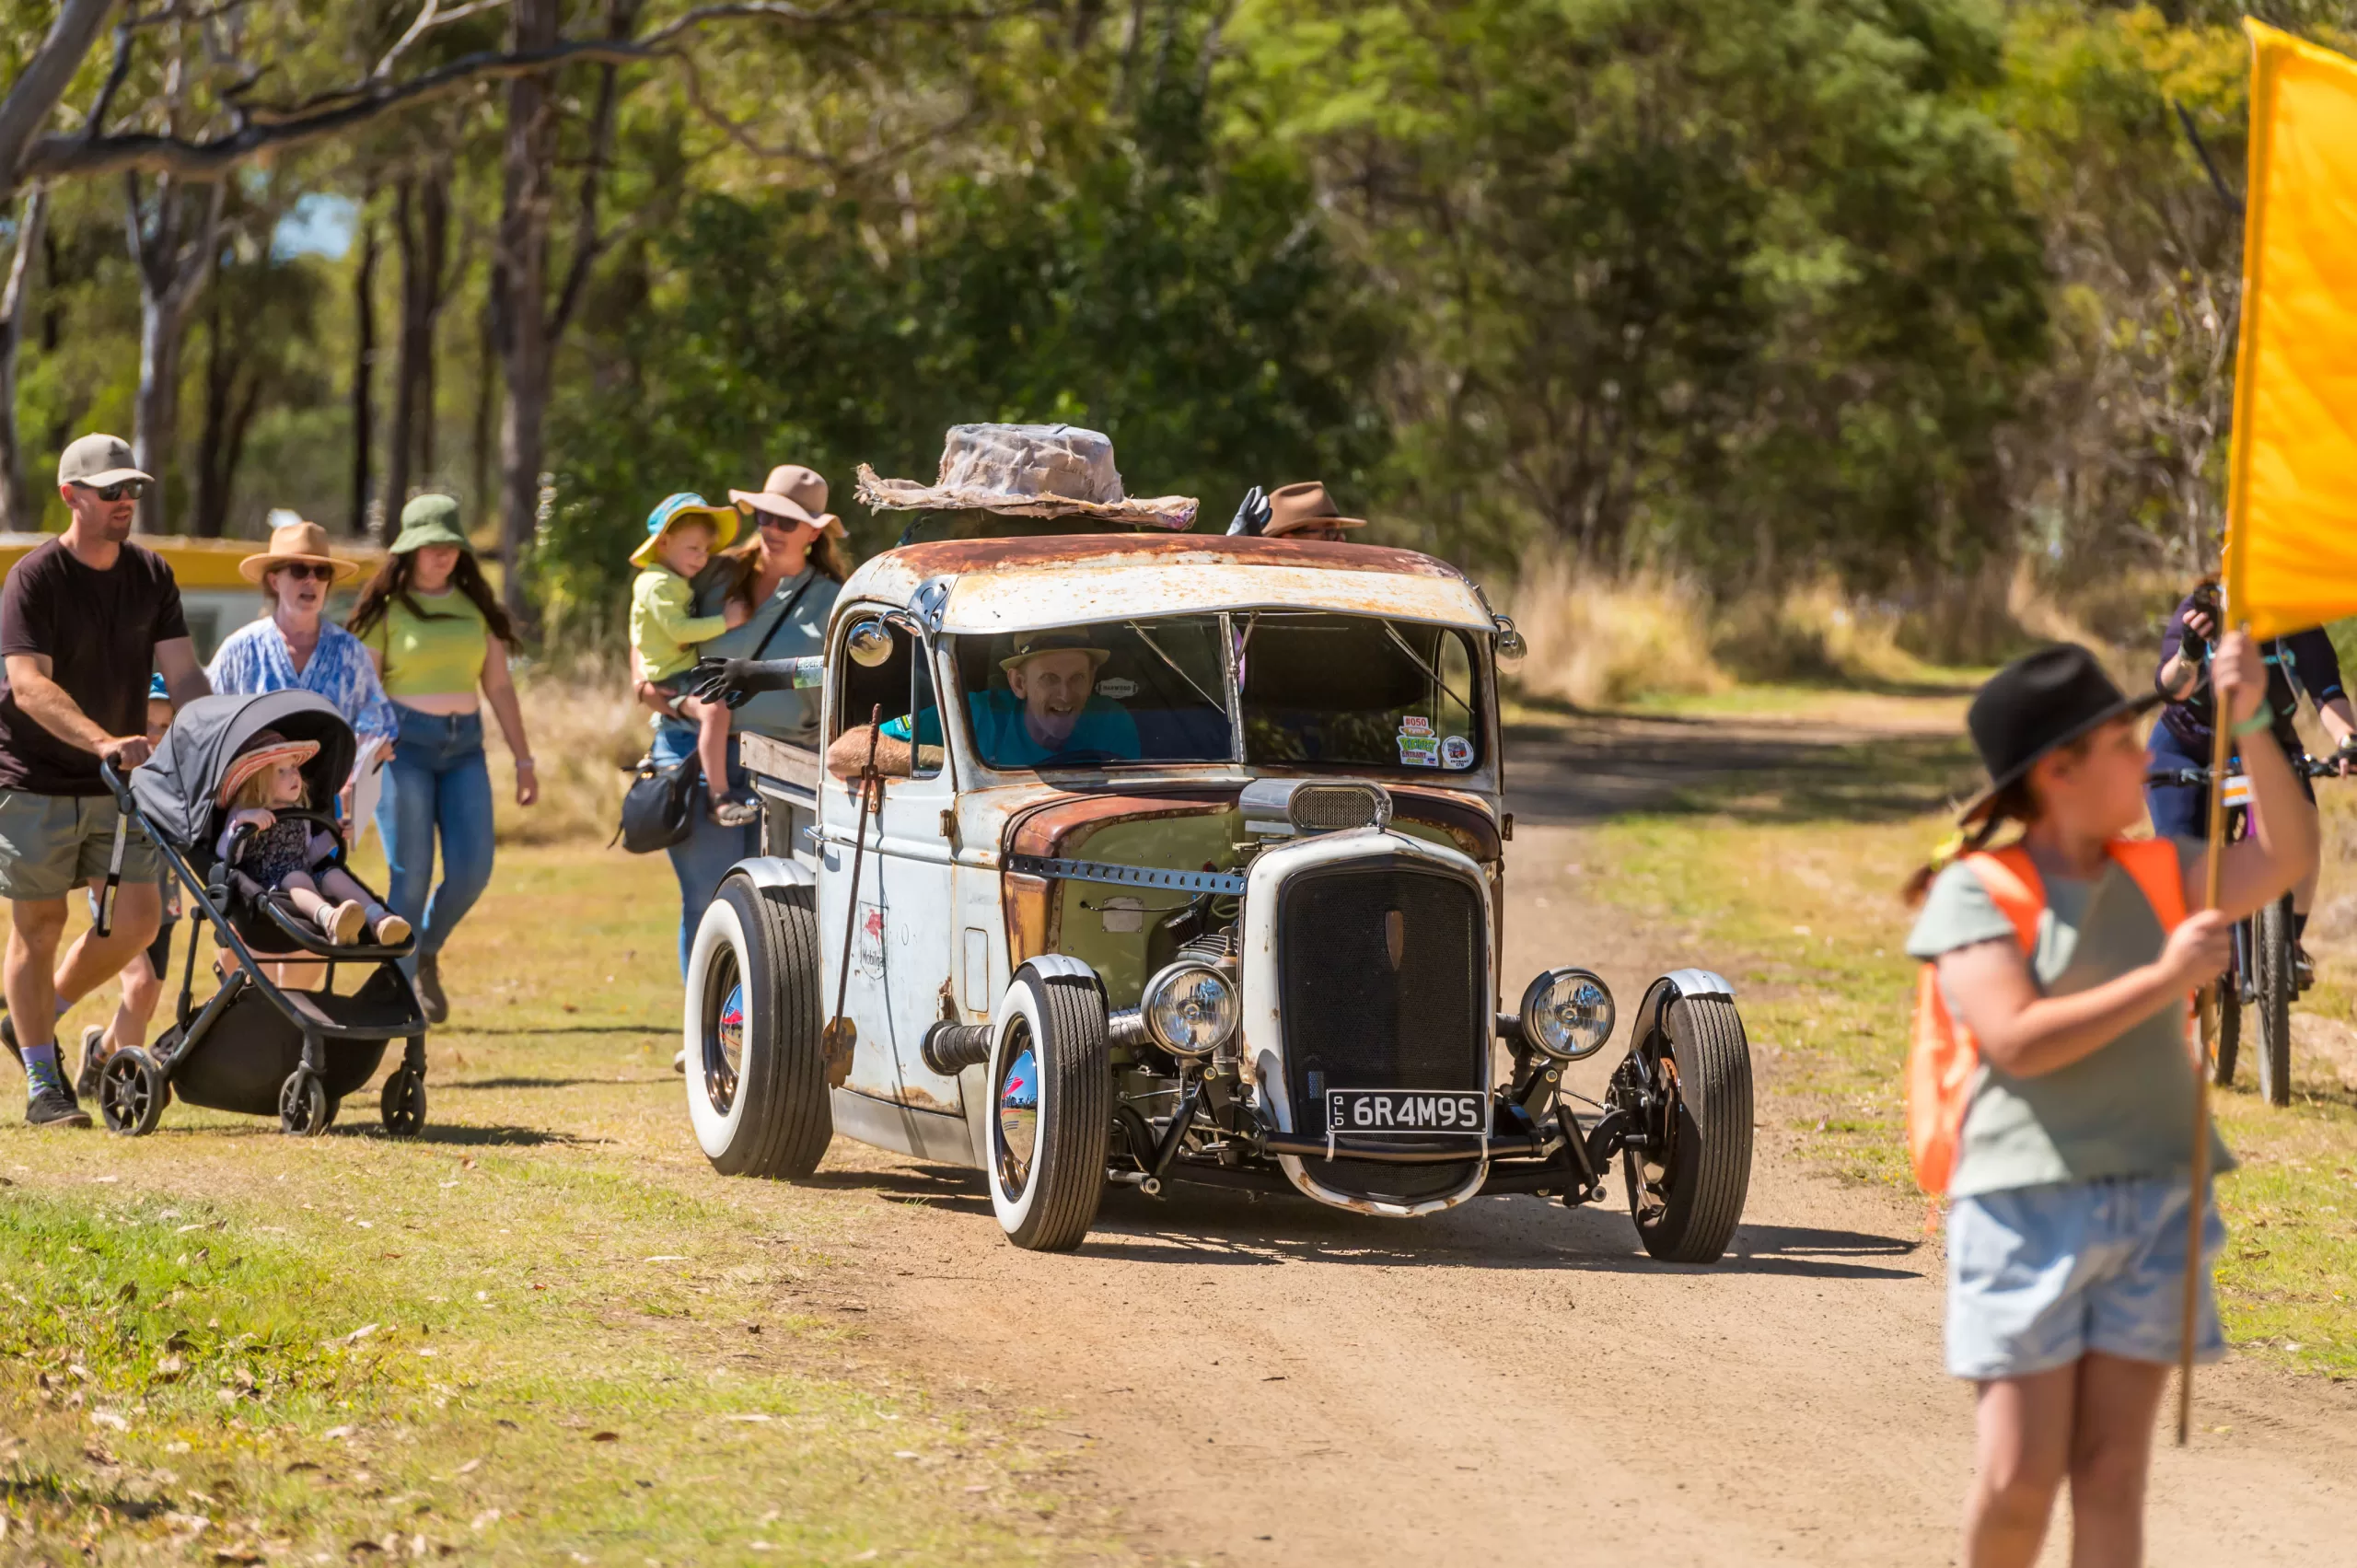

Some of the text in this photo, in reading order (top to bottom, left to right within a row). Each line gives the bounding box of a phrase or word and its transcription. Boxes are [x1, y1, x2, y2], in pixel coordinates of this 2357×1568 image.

[1405, 718, 1427, 726] #050
[1401, 750, 1427, 759] ENTRANT
[1334, 1096, 1343, 1126] QLD
[1353, 1097, 1478, 1127] 6R4M9S
